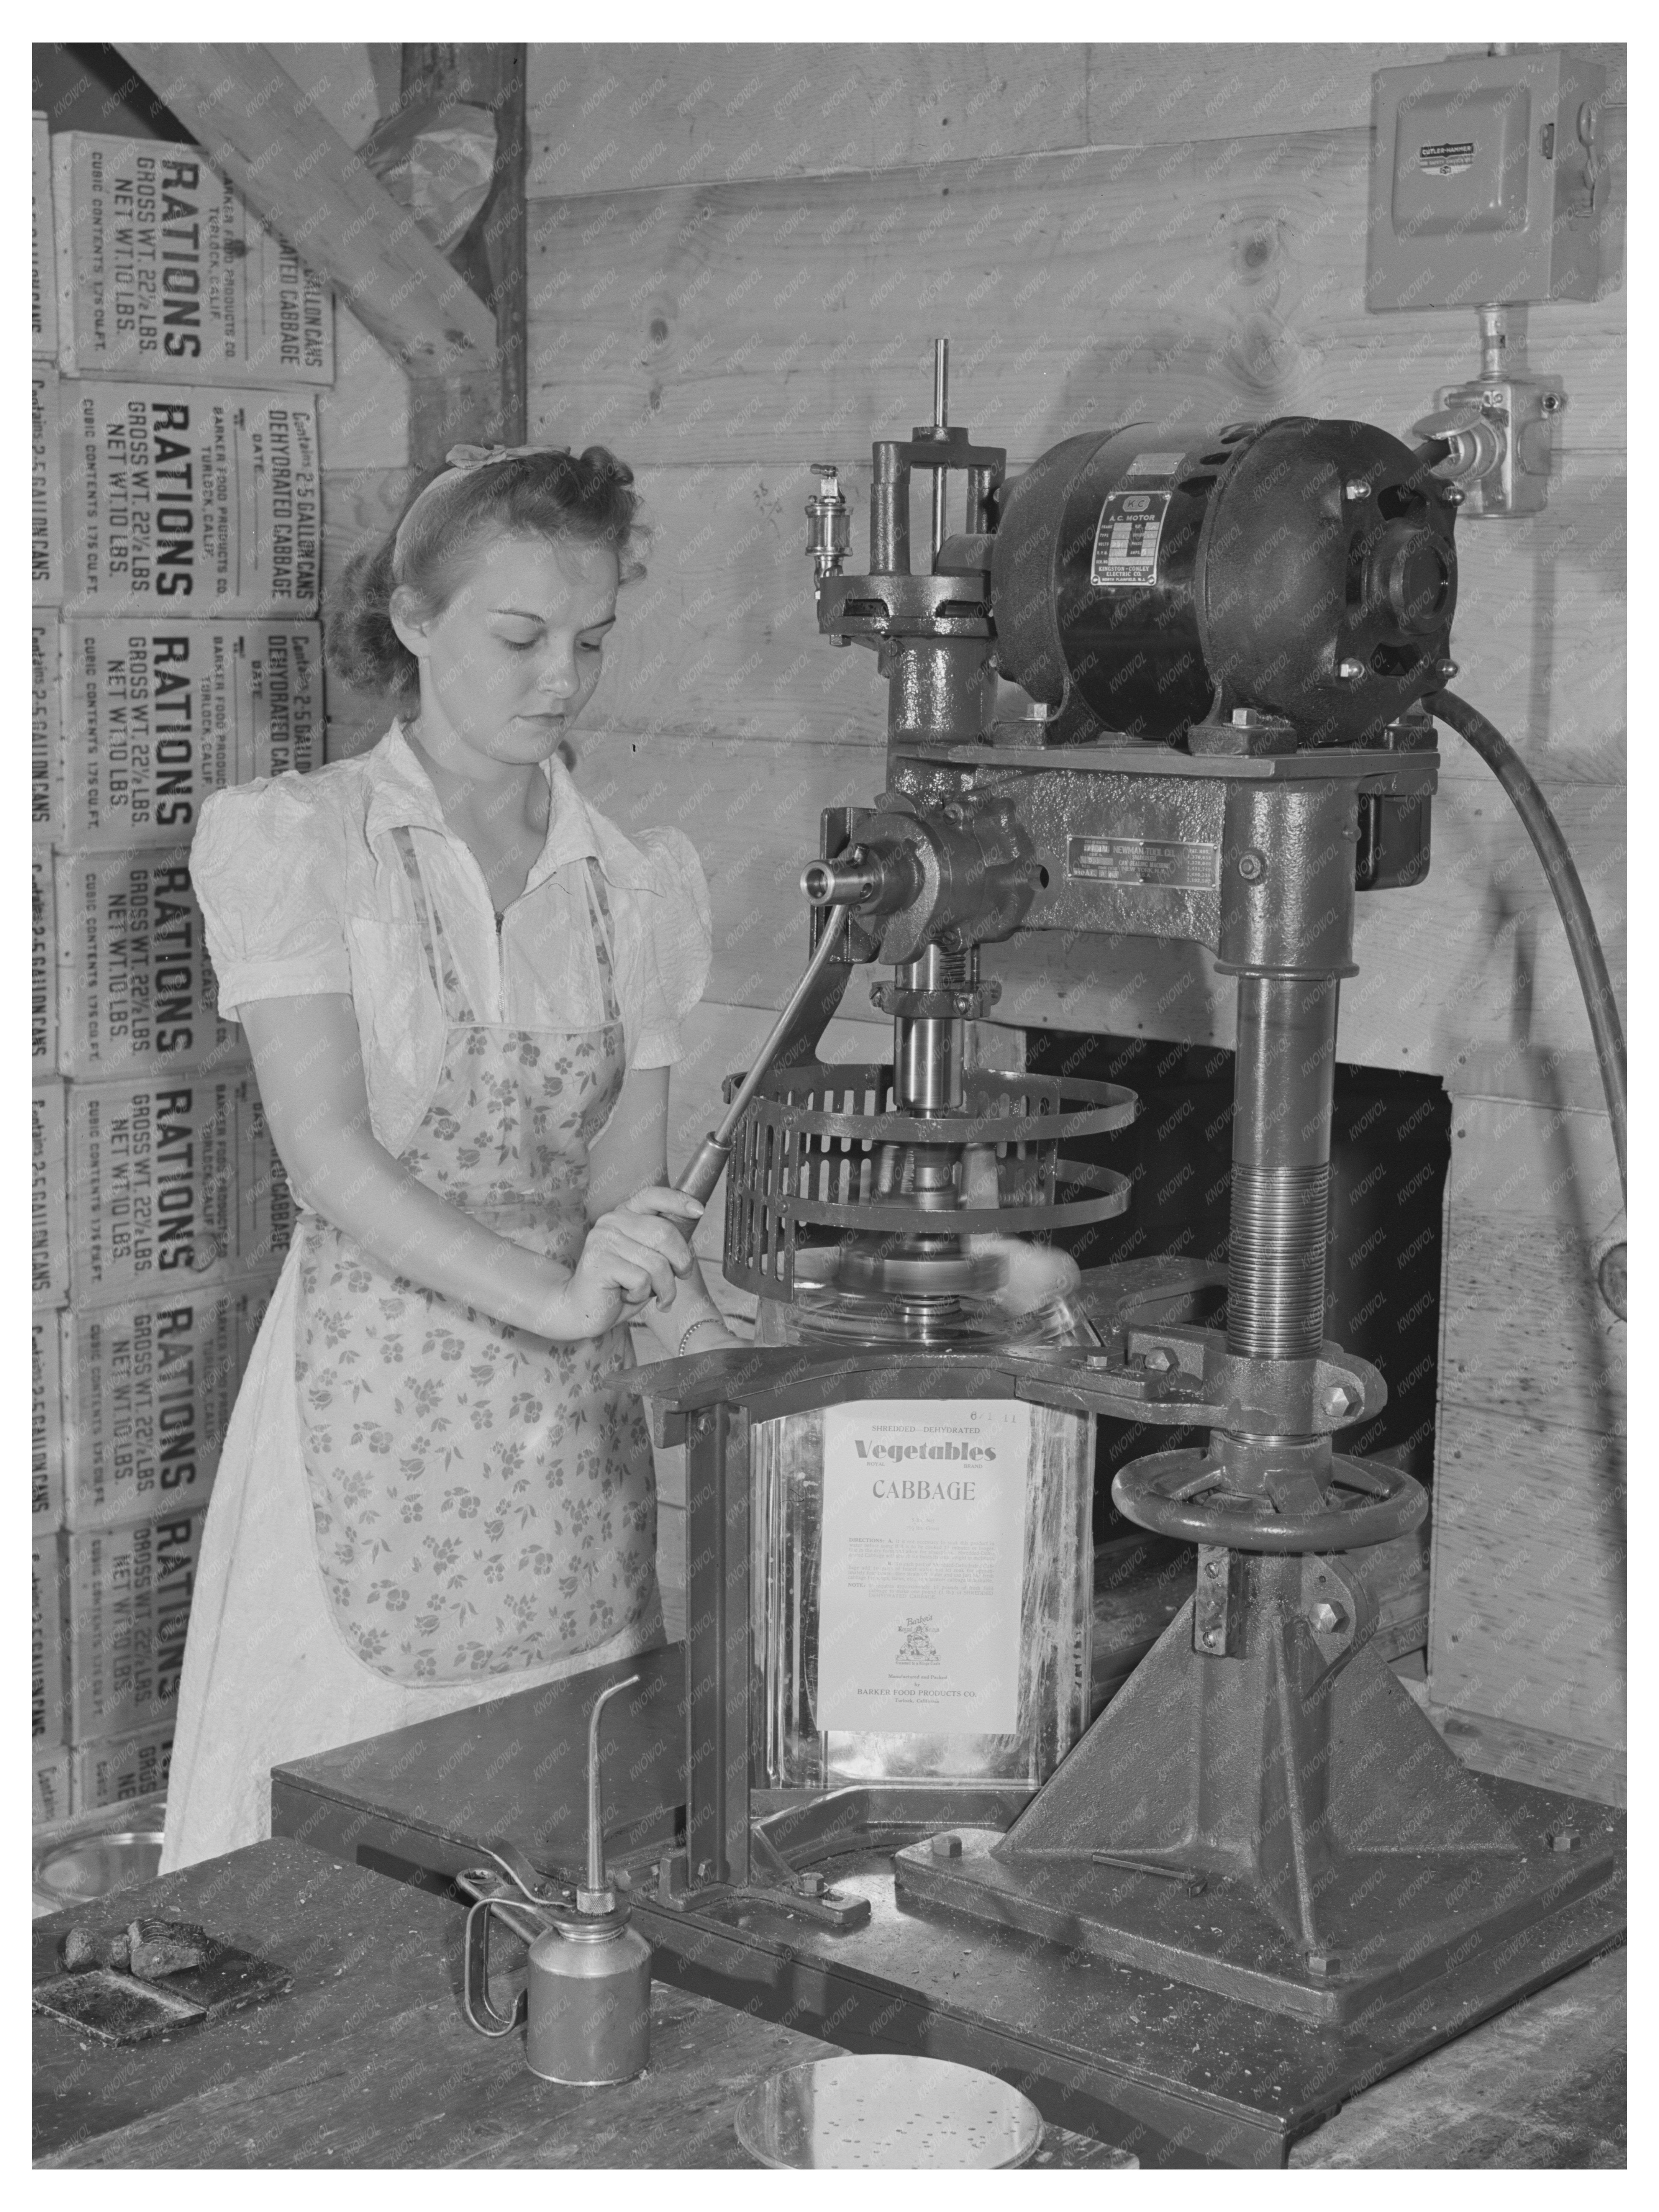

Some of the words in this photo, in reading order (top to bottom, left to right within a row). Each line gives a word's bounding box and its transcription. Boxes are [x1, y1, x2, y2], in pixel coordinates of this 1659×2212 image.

[1422, 146, 1471, 155] CUTLER-HAMMER
[92, 152, 103, 192] CUBIC
[137, 157, 156, 223] GROSS
[115, 179, 133, 219] NET
[93, 199, 103, 273] CONTENTS
[137, 229, 156, 262] WT.
[162, 159, 200, 357] RATIONS
[116, 291, 135, 335] LBS.
[224, 269, 236, 336] PRODUCTS
[138, 315, 157, 355] LBS.
[280, 290, 300, 365] CABBAGE
[305, 329, 322, 367] CANS
[83, 399, 95, 438] CUBIC
[128, 402, 149, 466] GROSS
[213, 407, 226, 462] BARKER
[107, 425, 126, 463] NET
[252, 434, 264, 473] DATE
[269, 410, 292, 518] DEHYDRATED
[85, 444, 97, 517] CONTENTS
[131, 471, 149, 505] WT.
[152, 403, 193, 596] RATIONS
[216, 467, 227, 501] FOOD
[217, 507, 228, 574] PRODUCTS
[297, 502, 315, 558] GALLON
[32, 541, 50, 580] CANS
[109, 535, 128, 577] LBS.
[273, 525, 292, 599] CABBAGE
[296, 562, 315, 599] CANS
[85, 638, 96, 676] CUBIC
[129, 637, 148, 699] GROSS
[108, 660, 126, 699] NET
[268, 635, 289, 742] DEHYDRATED
[87, 683, 97, 754] CONTENTS
[131, 706, 149, 739] WT.
[153, 637, 193, 825] RATIONS
[32, 783, 50, 822] CANS
[131, 789, 150, 827] LBS.
[1113, 845, 1144, 855] NEWMAN
[1146, 848, 1162, 856] TOOL
[108, 894, 126, 932] NET
[130, 870, 148, 931] GROSS
[131, 936, 149, 970] WT.
[153, 867, 193, 1053] RATIONS
[109, 1000, 128, 1042] LBS.
[132, 1018, 150, 1056] LBS.
[111, 1119, 129, 1155] NET
[133, 1094, 150, 1154] GROSS
[156, 1089, 193, 1271] RATIONS
[32, 1252, 51, 1291] CANS
[134, 1238, 152, 1276] LBS.
[134, 1314, 152, 1376] GROSS
[157, 1307, 196, 1489] RATIONS
[855, 1440, 996, 1463] Vegetables
[873, 1480, 975, 1500] CABBAGE
